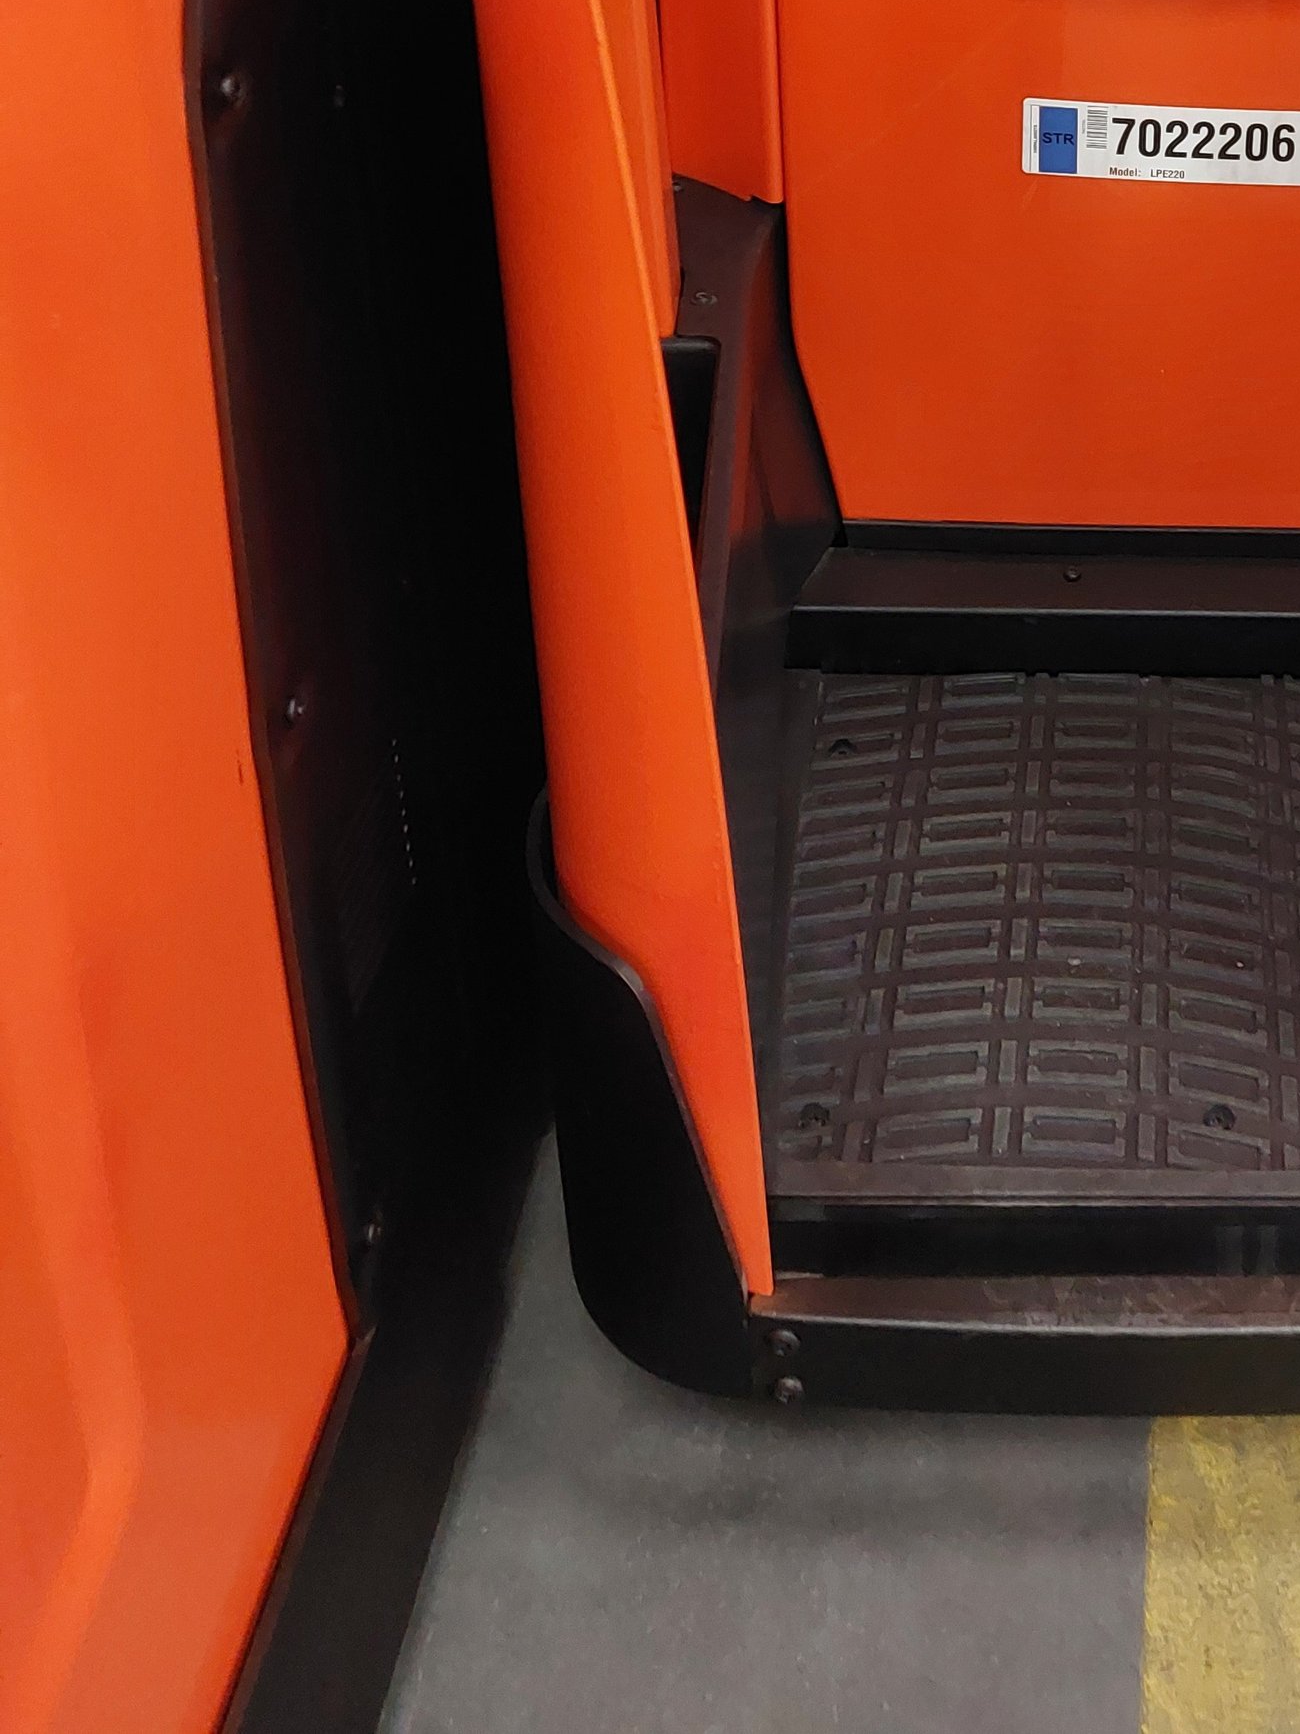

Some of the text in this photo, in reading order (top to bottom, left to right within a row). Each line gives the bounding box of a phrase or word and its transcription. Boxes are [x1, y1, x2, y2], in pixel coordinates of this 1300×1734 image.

[1042, 131, 1075, 146] STR
[1112, 117, 1296, 162] 7022206
[1109, 166, 1185, 179] Model: LPE220
